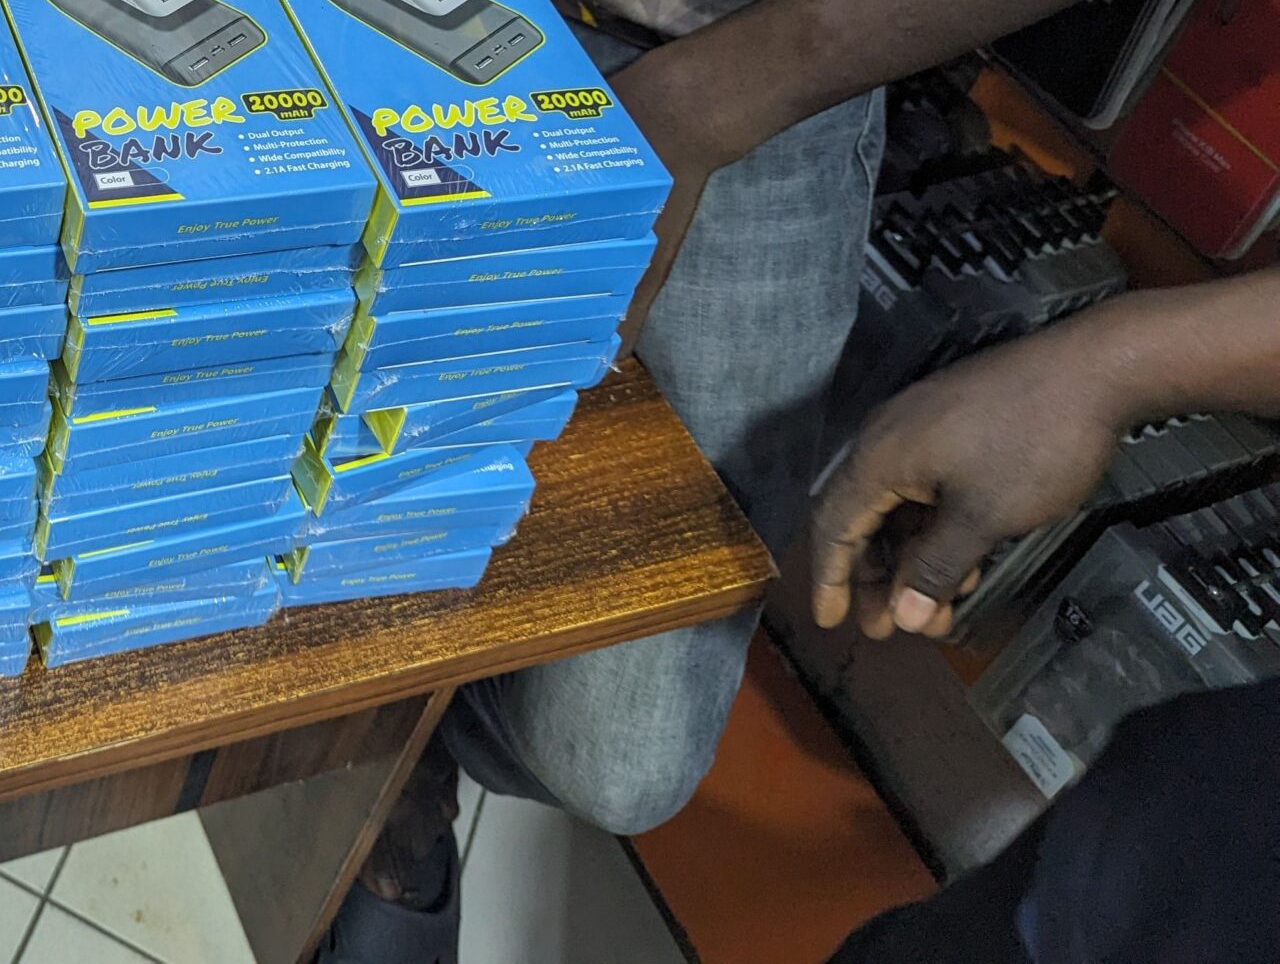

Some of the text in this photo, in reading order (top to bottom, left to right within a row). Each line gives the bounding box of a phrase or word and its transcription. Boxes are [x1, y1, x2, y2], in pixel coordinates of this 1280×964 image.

[249, 91, 323, 110] 20000
[539, 90, 608, 110] 20000
[72, 96, 245, 139] POWER
[280, 108, 308, 118] mAh
[371, 95, 537, 136] POWER
[570, 107, 597, 118] mAh
[248, 126, 304, 140] Dual Output
[542, 126, 595, 139] Dual Output
[254, 136, 328, 151] Multi-Protection
[382, 129, 520, 168] BANK
[549, 135, 619, 149] Multi-Protection
[79, 131, 223, 171] BANK
[258, 147, 346, 163] Wide Compatibility
[555, 145, 638, 161] Wide Compatibility
[264, 158, 350, 175] 2.1A Fast Charging
[563, 156, 644, 173] 2.1A Fast Charging
[100, 174, 126, 185] Color
[408, 171, 432, 182] Color
[859, 266, 898, 311] AG
[1134, 579, 1207, 655] UAG
